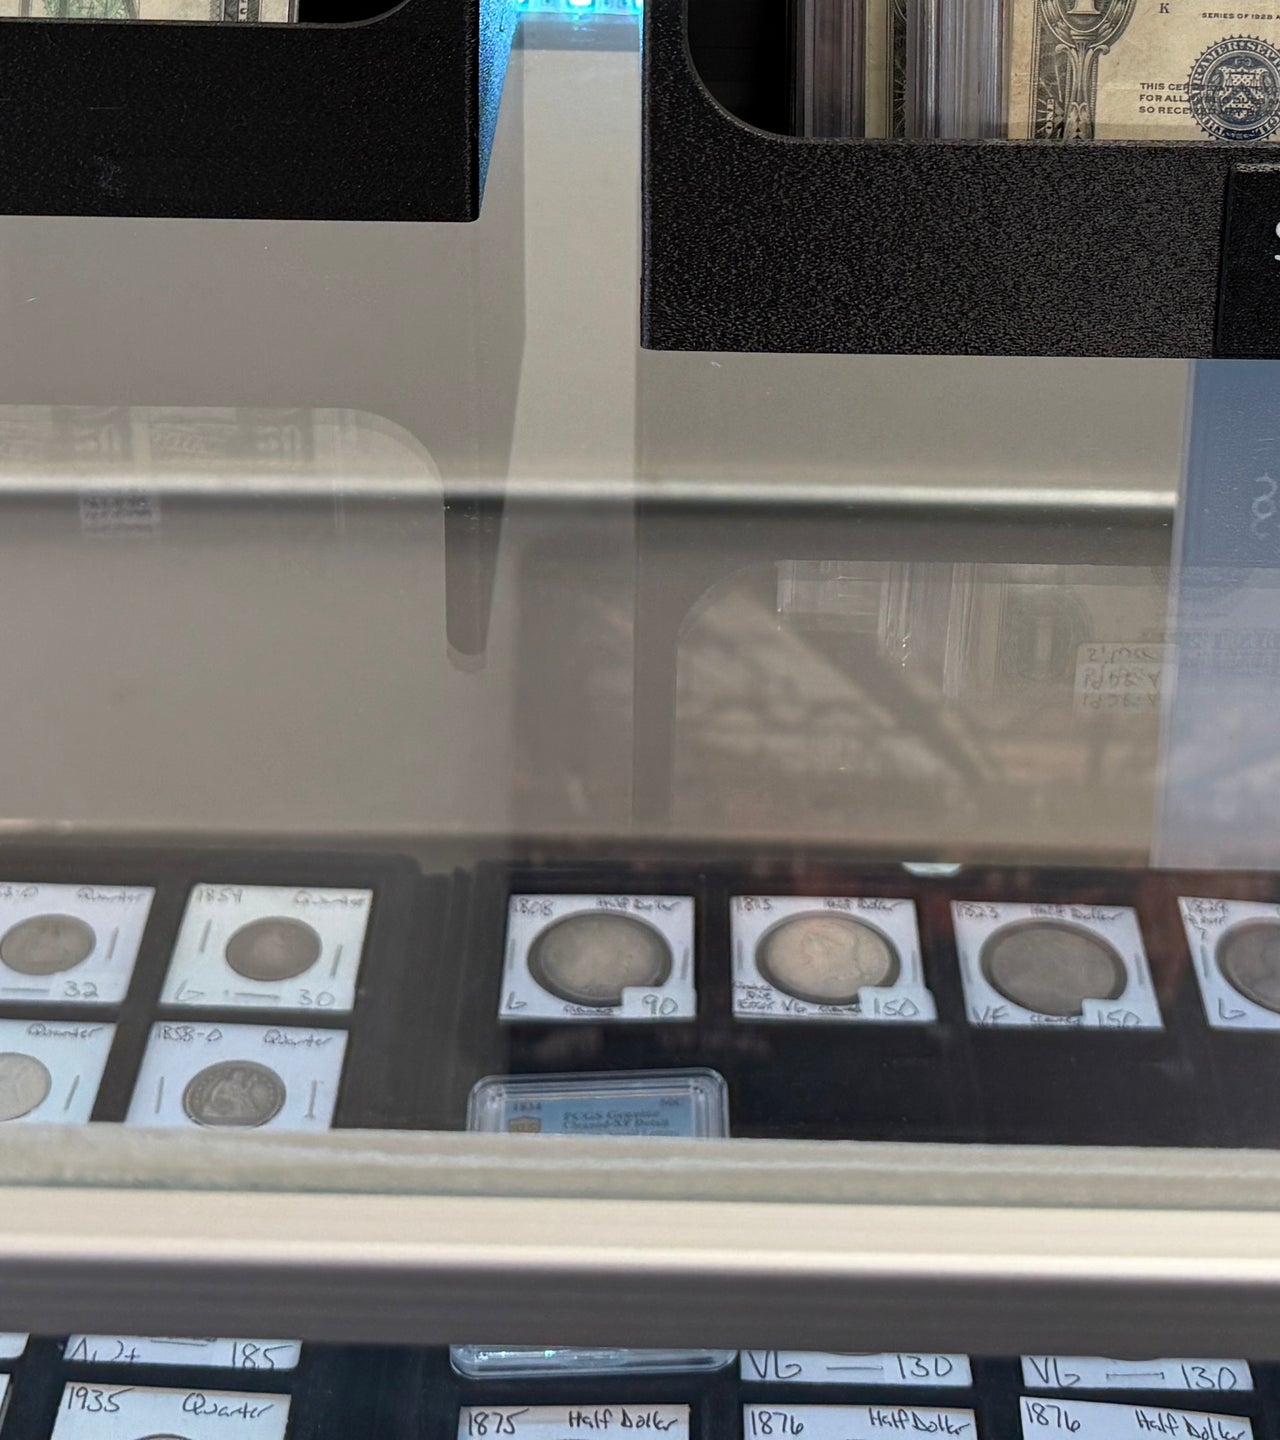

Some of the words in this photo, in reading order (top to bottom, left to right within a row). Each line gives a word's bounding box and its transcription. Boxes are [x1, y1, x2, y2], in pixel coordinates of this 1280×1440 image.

[1160, 3, 1170, 14] K
[62, 980, 99, 998] 32
[297, 989, 336, 1006] 30
[641, 994, 678, 1015] 90
[874, 998, 919, 1017] 150
[230, 1341, 294, 1370] 185
[895, 1355, 952, 1380] 130
[1180, 1362, 1239, 1391] 130
[67, 1384, 135, 1414] 1935
[182, 1391, 273, 1419] Quarter
[467, 1409, 530, 1435] 1875
[568, 1408, 612, 1429] Half
[620, 1407, 679, 1431] Dollar
[750, 1409, 805, 1434] 1876
[868, 1407, 912, 1429] Half
[912, 1409, 971, 1434] Dollar
[1024, 1402, 1082, 1433] 1876
[1135, 1409, 1179, 1437] Half
